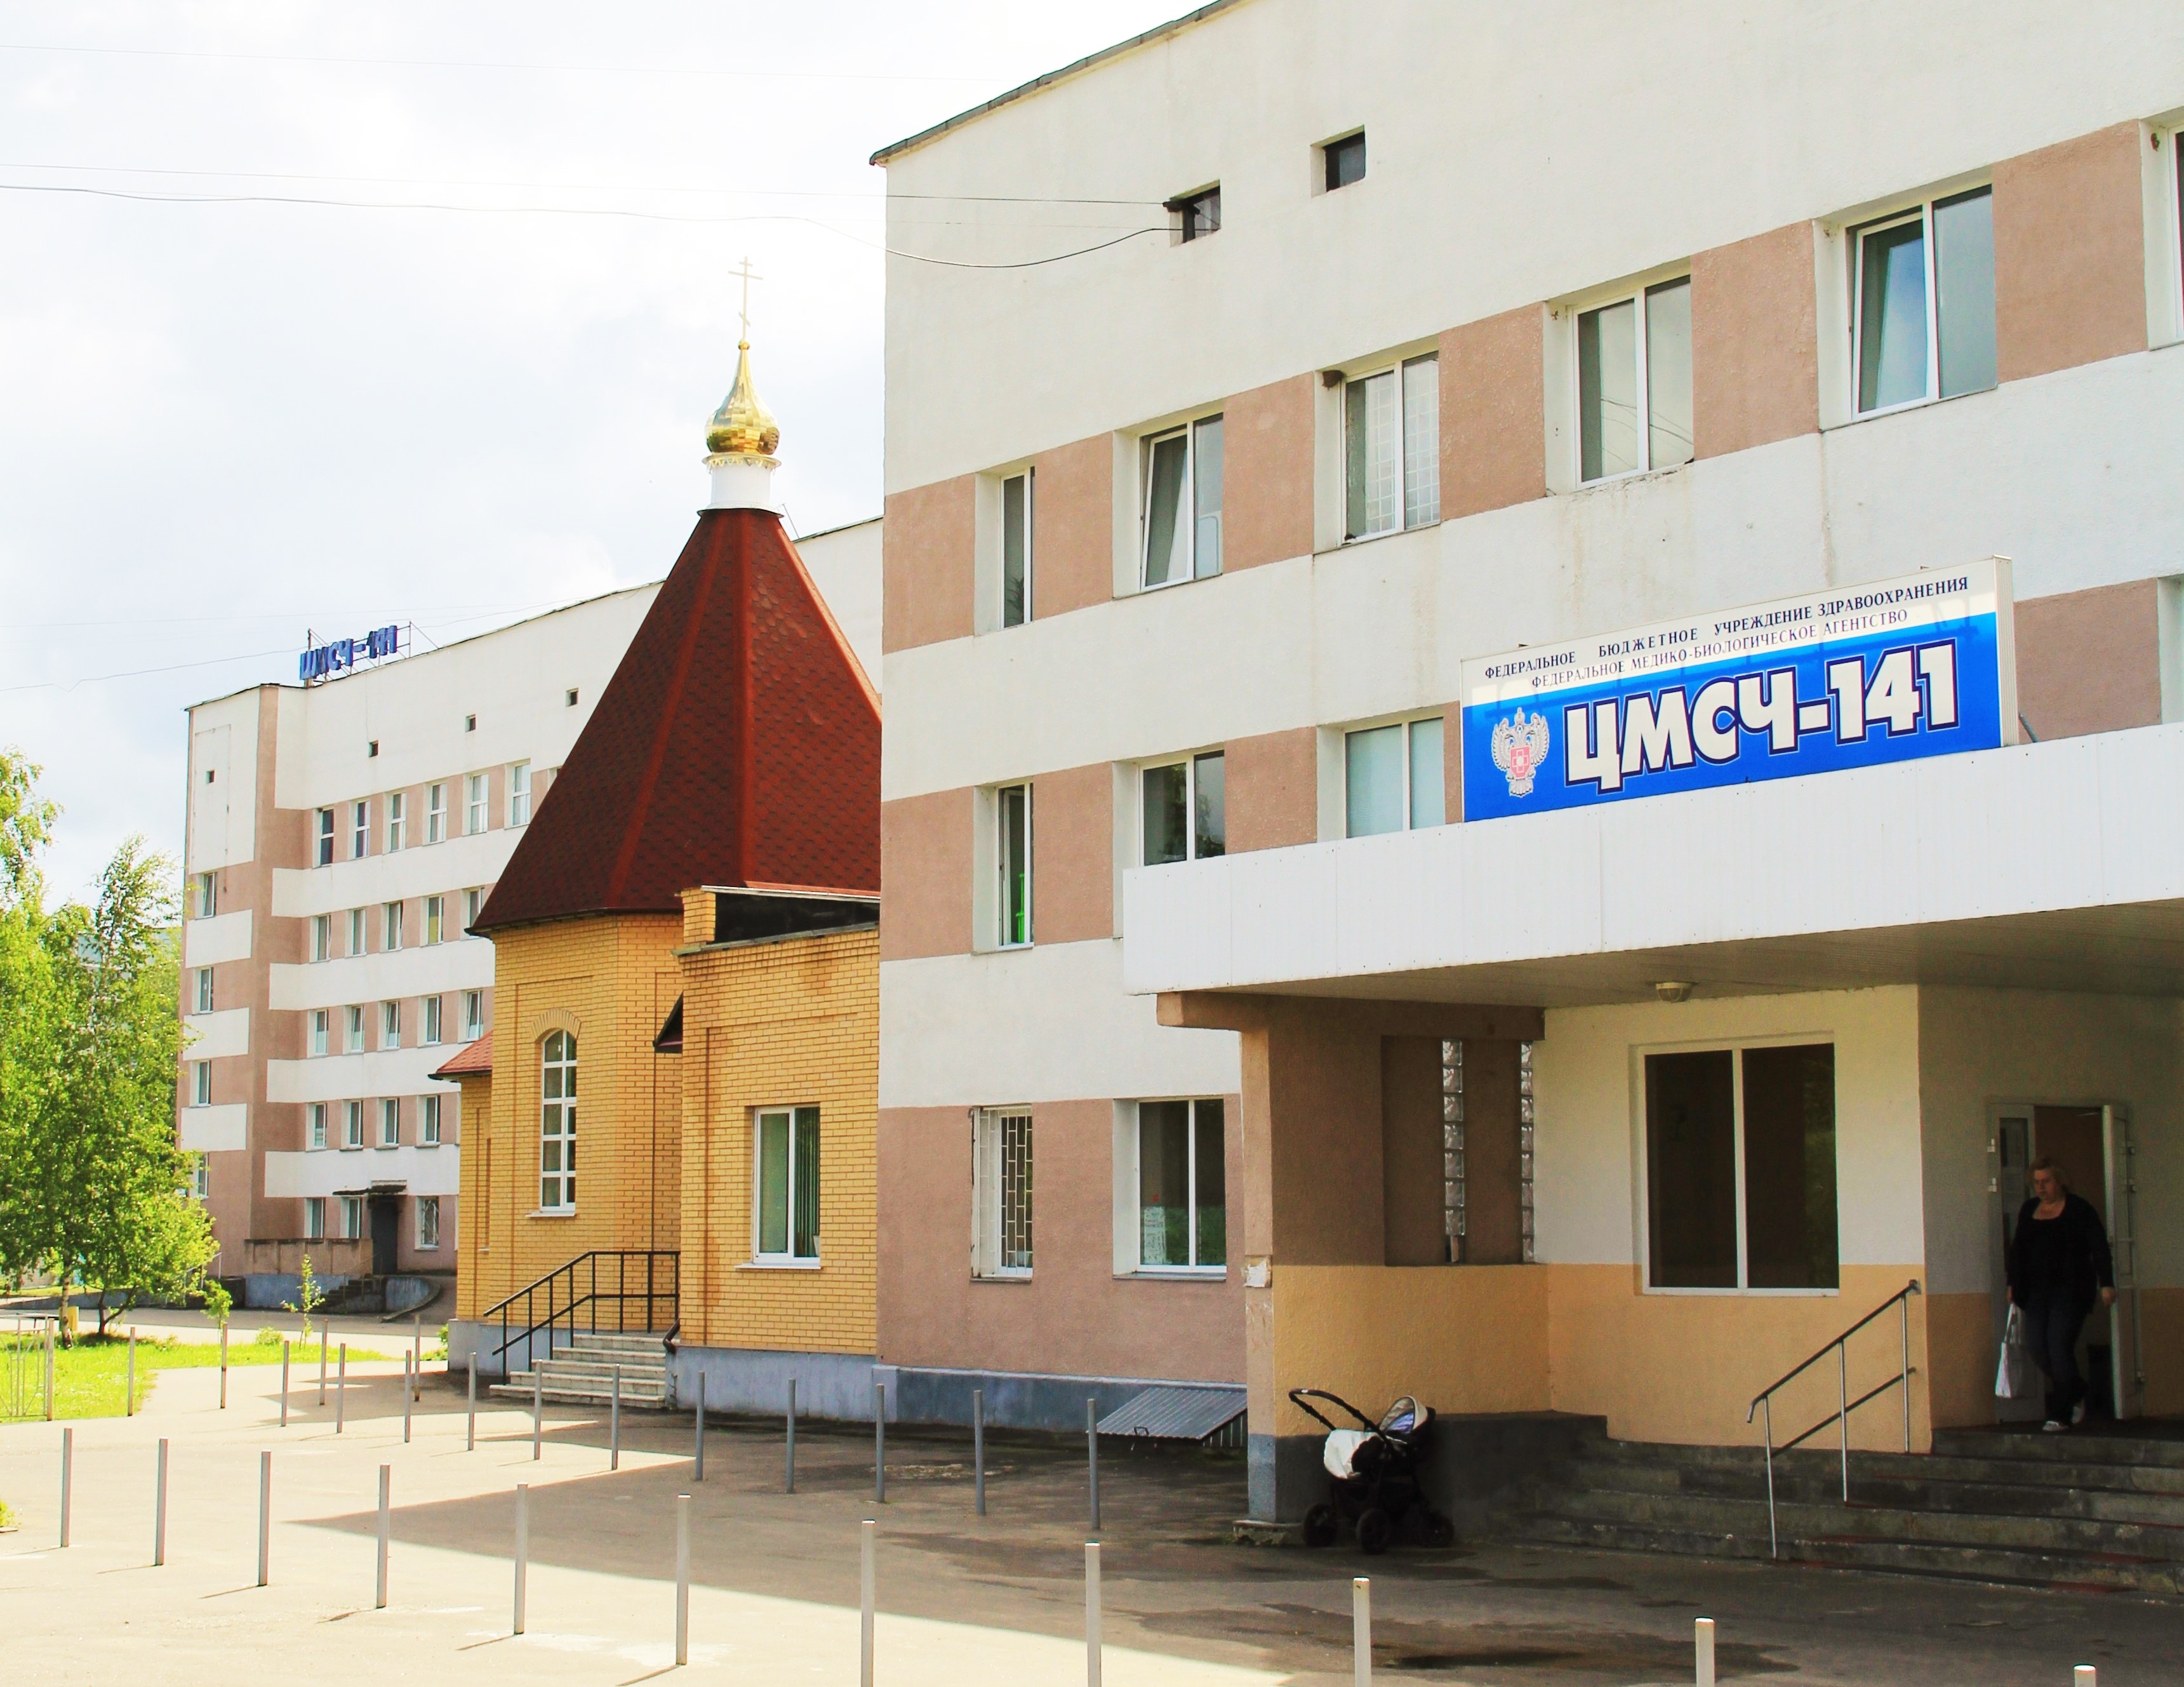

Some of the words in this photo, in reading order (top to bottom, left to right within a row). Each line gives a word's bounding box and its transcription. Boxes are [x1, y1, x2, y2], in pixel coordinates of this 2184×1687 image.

[1484, 651, 1576, 680] ФЕДЕРАЛЬНОЕ
[1598, 627, 1698, 658] БЮДЖЕТНОЕ
[1714, 605, 1813, 636] УЧРЕЖДЕНИЕ
[1817, 576, 1969, 617] ЗДРАВООХРАНЕНИЯ
[1531, 660, 1625, 689] ФЕДЕРАЛЬНОЕ
[1630, 623, 1818, 671] МЕДИКО-БИОЛОГИЧЕСКОЕ
[1822, 608, 1908, 636] АГЕНТСТВО
[1564, 638, 1959, 795] ЦМСЧ-141
